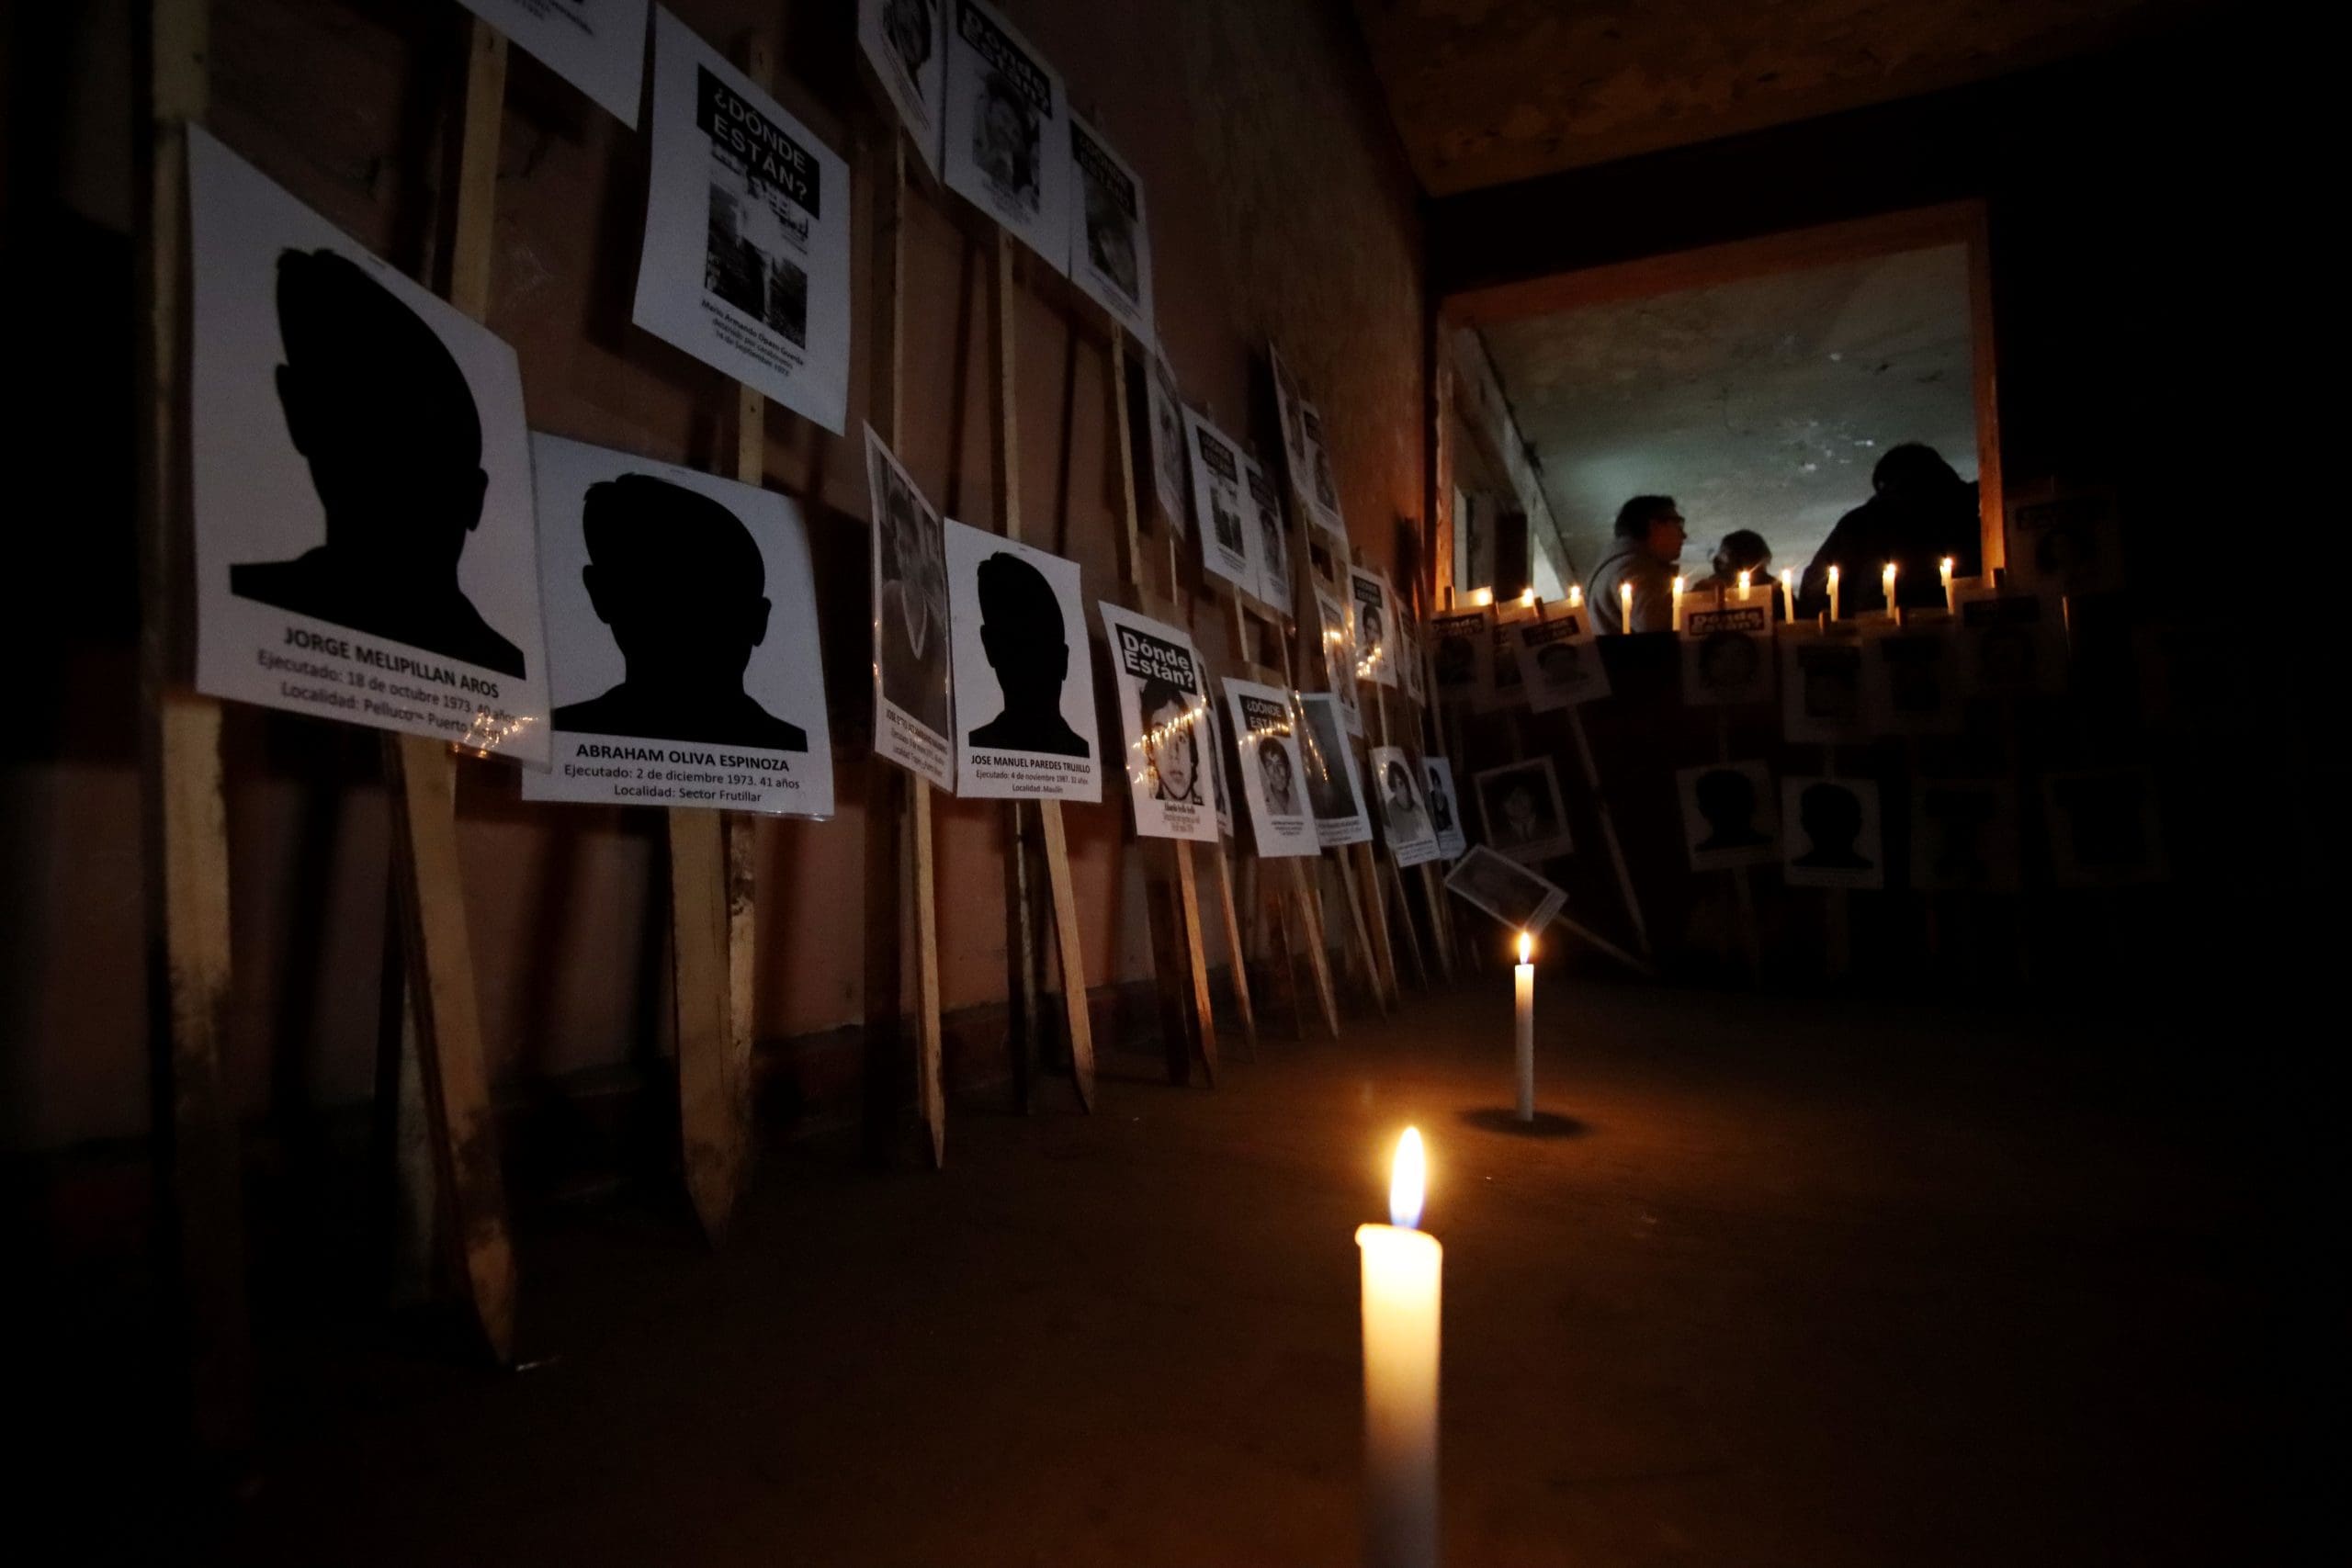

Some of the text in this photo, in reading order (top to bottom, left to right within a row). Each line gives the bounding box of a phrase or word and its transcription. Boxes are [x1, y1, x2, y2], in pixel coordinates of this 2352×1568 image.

[713, 88, 807, 175] ¿DÓNDE
[713, 113, 808, 200] ESTÁN?
[284, 627, 499, 698] JORGE MELIPILLAN AROS
[1122, 631, 1189, 670] Dónde
[1124, 649, 1194, 689] Están?
[257, 649, 344, 682] Ejecutado:
[348, 671, 366, 687] 18
[369, 677, 386, 693] de
[390, 684, 440, 705] octubre
[444, 695, 473, 715] 1973.
[281, 681, 359, 709] Localidad:
[429, 712, 468, 732] Puerto
[564, 764, 800, 790] Ejecutado: 2 de diciembre 1973. 41 años
[576, 744, 789, 772] ABRAHAM OLIVA ESPINOZA
[971, 755, 991, 765] JOSE
[993, 756, 1028, 768] MANUEL
[1030, 759, 1062, 771] PAREDES
[1016, 772, 1024, 780] de
[1025, 773, 1055, 783] noviembre
[614, 784, 762, 802] Localidad: Sector Frutillar
